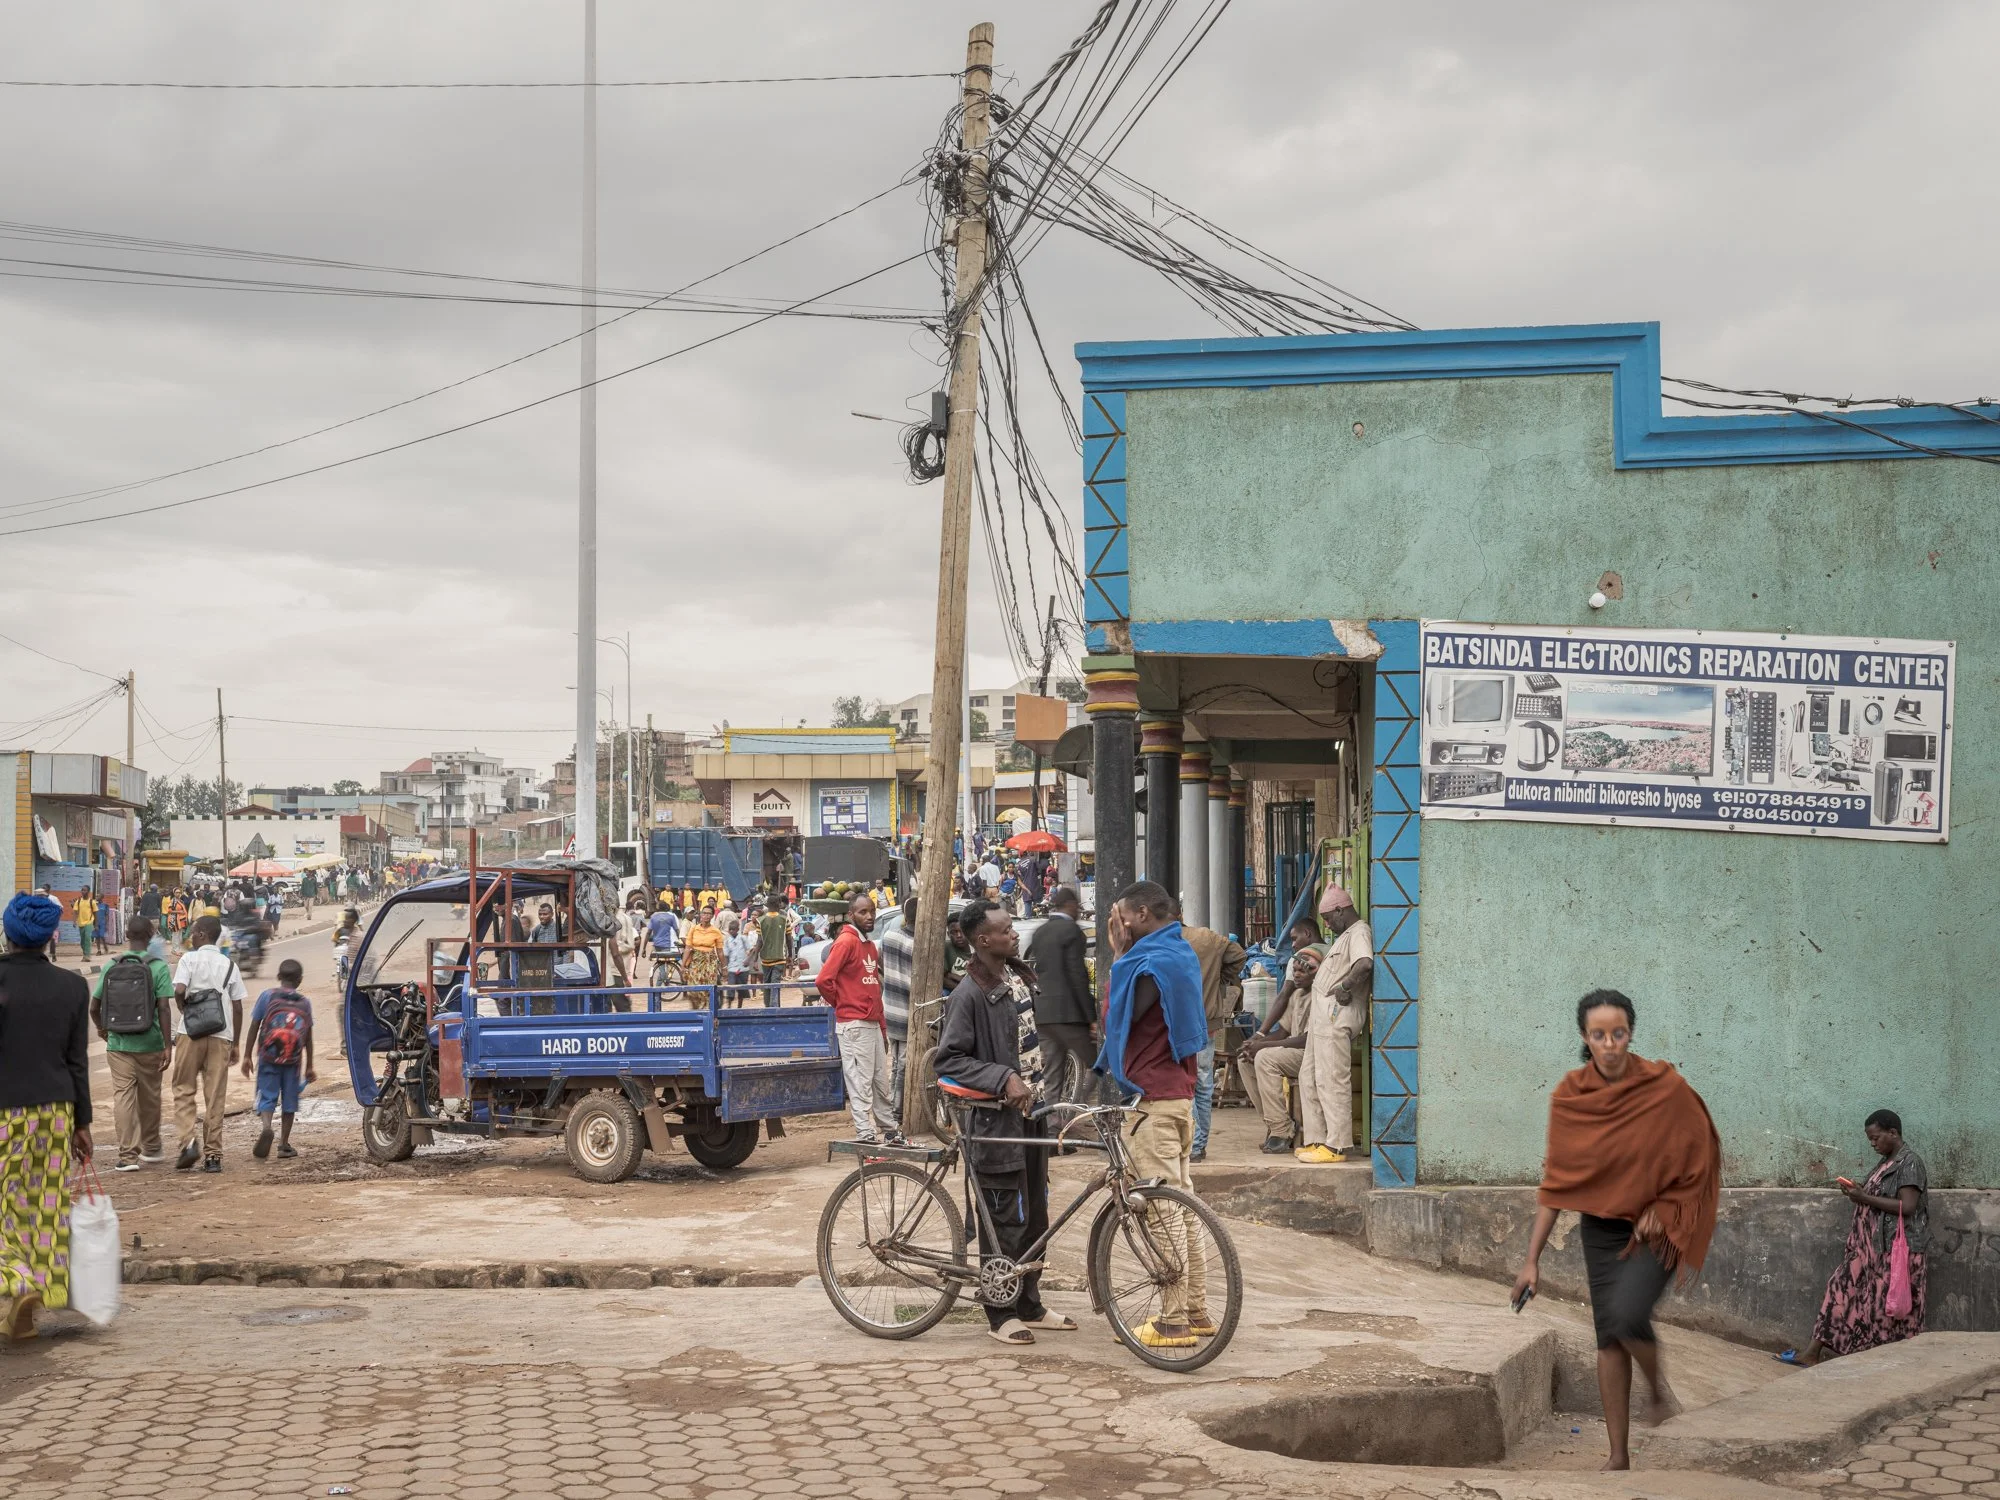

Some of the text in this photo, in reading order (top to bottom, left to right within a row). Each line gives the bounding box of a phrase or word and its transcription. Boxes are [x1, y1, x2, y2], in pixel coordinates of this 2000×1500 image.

[1426, 636, 1945, 686] BATSINDA ELECTRONICS REPARATION CENTER
[1508, 780, 1701, 813] dukora nibindi bikoresho byose
[1713, 791, 1866, 810] tel:0788454919
[1718, 806, 1839, 824] 0780450079
[542, 1037, 628, 1054] HARD BODY
